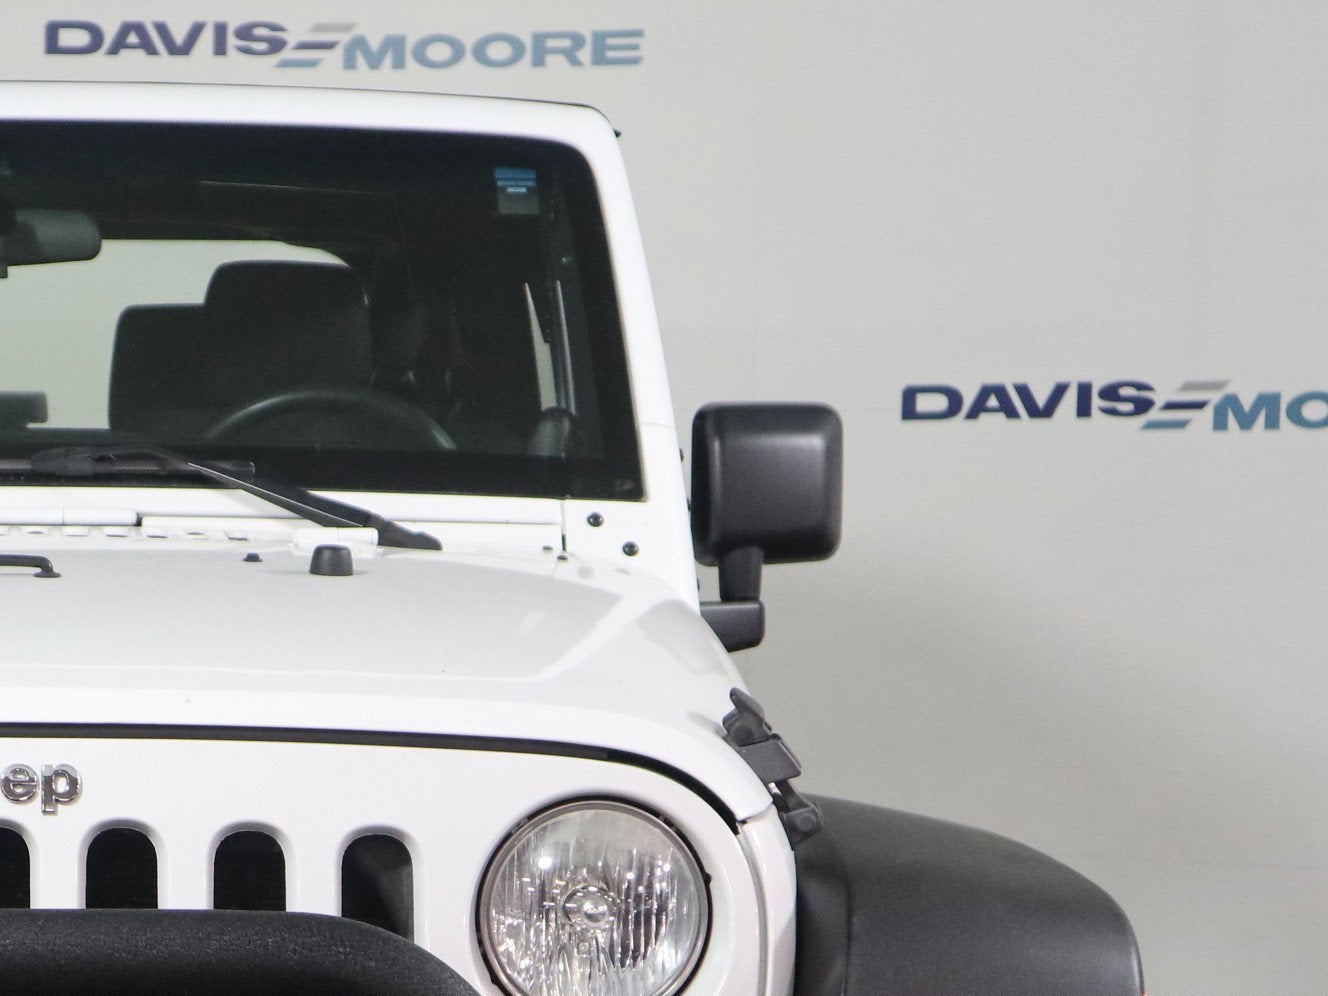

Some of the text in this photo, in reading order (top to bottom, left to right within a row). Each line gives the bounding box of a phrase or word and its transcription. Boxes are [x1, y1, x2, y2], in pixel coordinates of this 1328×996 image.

[43, 19, 645, 71] DAVIS MOORE
[900, 379, 1156, 421] DAVIS
